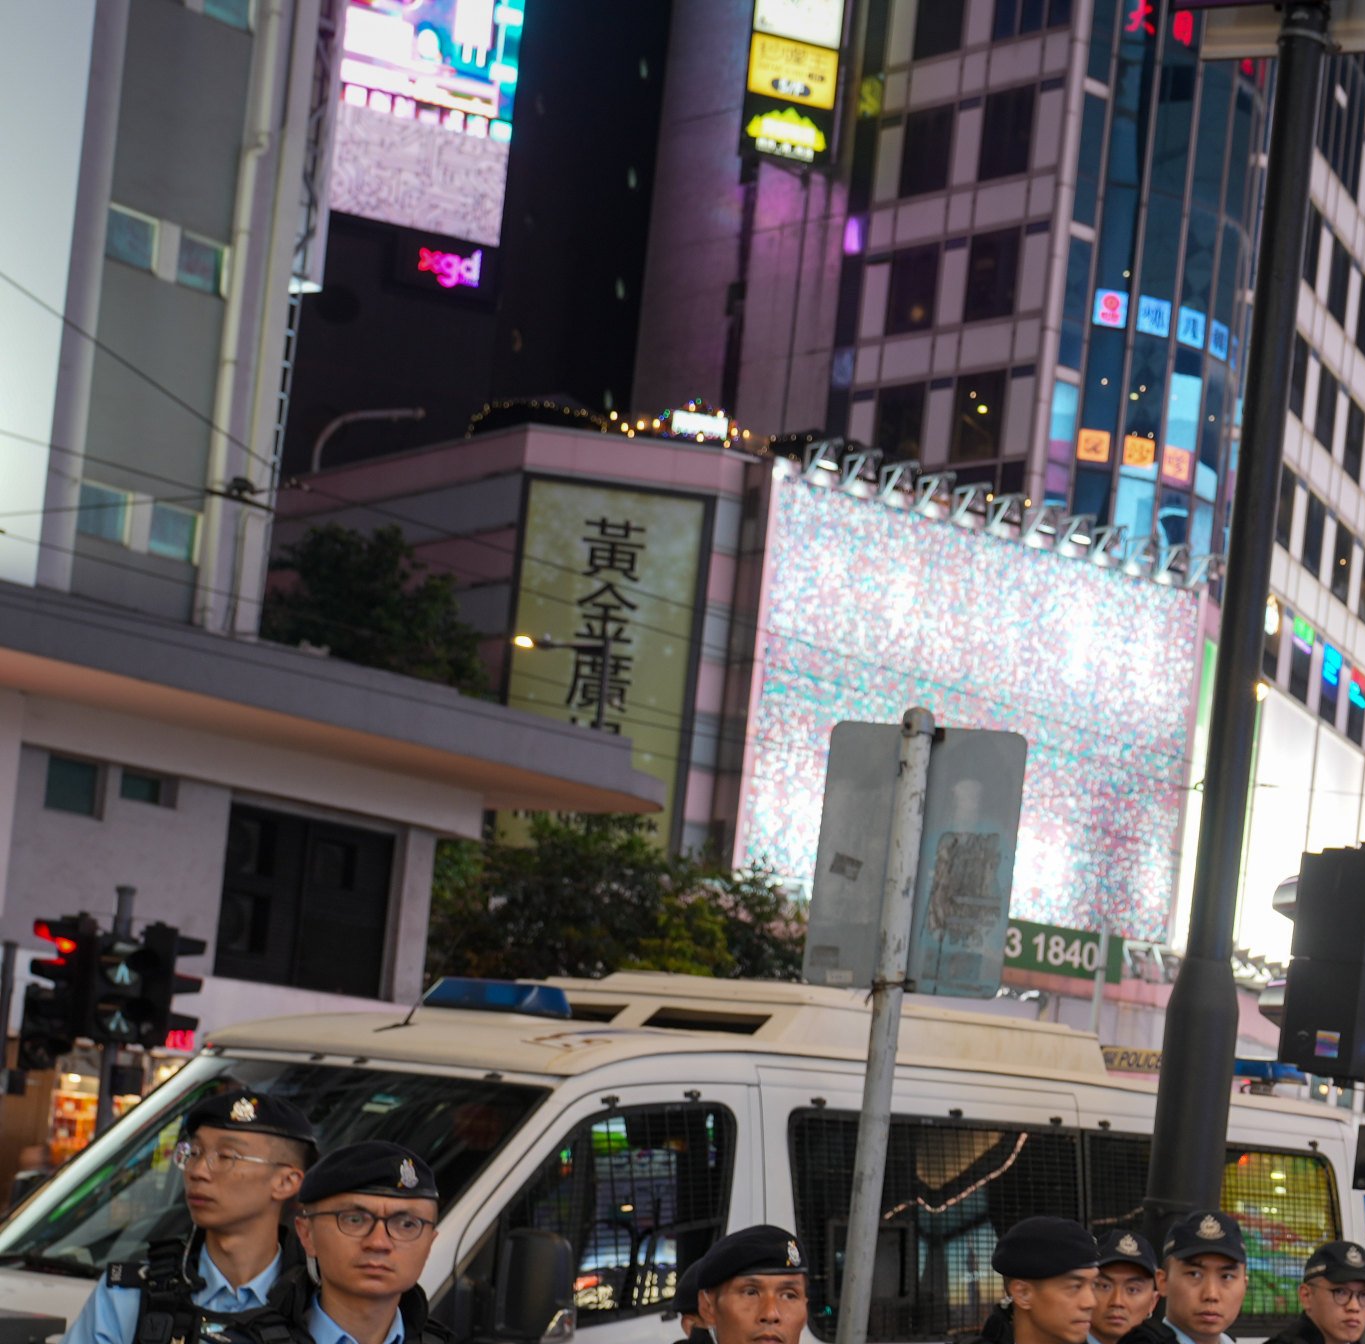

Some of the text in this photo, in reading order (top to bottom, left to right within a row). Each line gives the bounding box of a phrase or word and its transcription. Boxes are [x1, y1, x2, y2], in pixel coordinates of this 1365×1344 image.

[566, 517, 647, 736] 黃金廣
[1032, 932, 1100, 972] 1840
